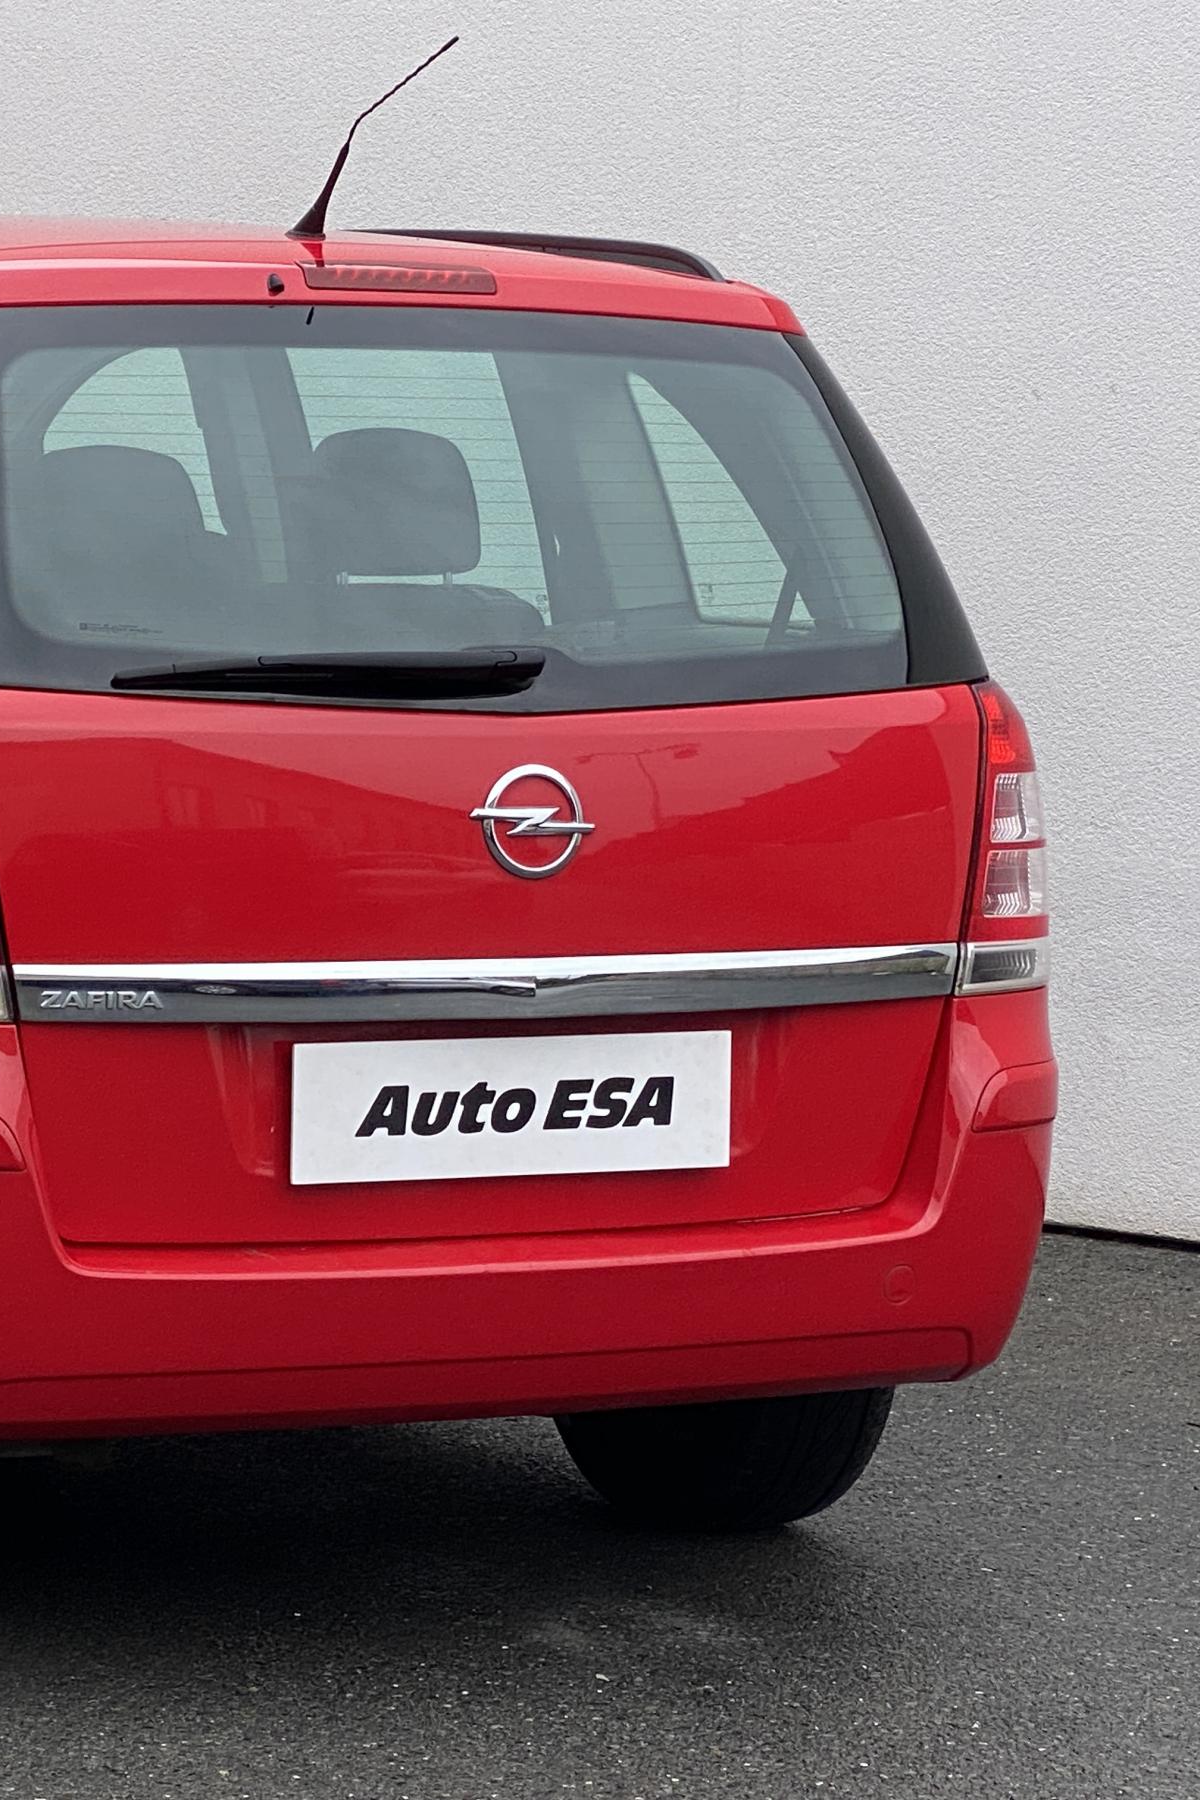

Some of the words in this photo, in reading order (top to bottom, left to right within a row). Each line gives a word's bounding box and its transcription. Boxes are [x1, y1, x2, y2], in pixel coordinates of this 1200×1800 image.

[40, 990, 164, 1010] ZAFIRA
[354, 1081, 537, 1137] Auto
[542, 1076, 674, 1130] ESA
